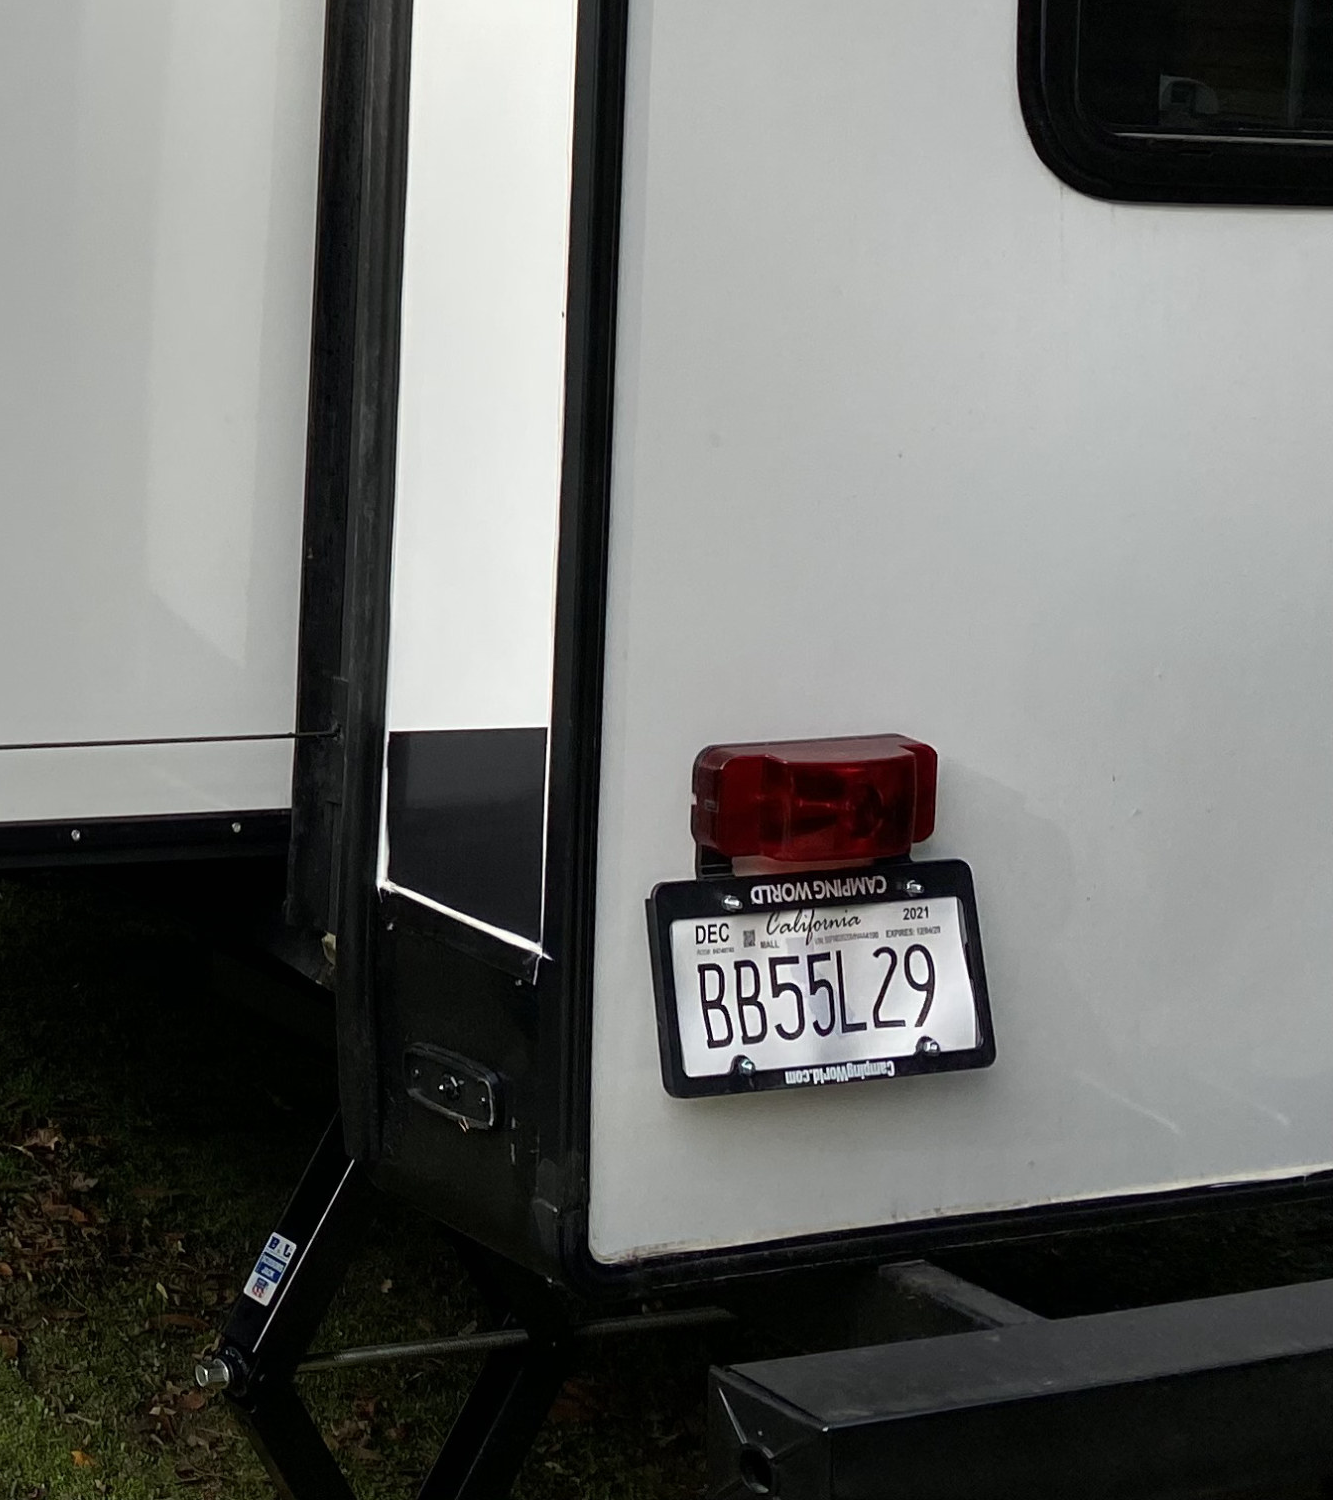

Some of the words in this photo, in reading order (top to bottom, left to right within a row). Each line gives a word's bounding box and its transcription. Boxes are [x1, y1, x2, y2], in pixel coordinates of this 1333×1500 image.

[750, 882, 812, 904] WORLD
[813, 875, 887, 899] CAMPING
[902, 906, 929, 920] 2021
[695, 922, 730, 945] DEC
[766, 908, 861, 946] California
[697, 944, 936, 1049] BB55L29
[784, 1060, 895, 1085] CampingWorld.com
